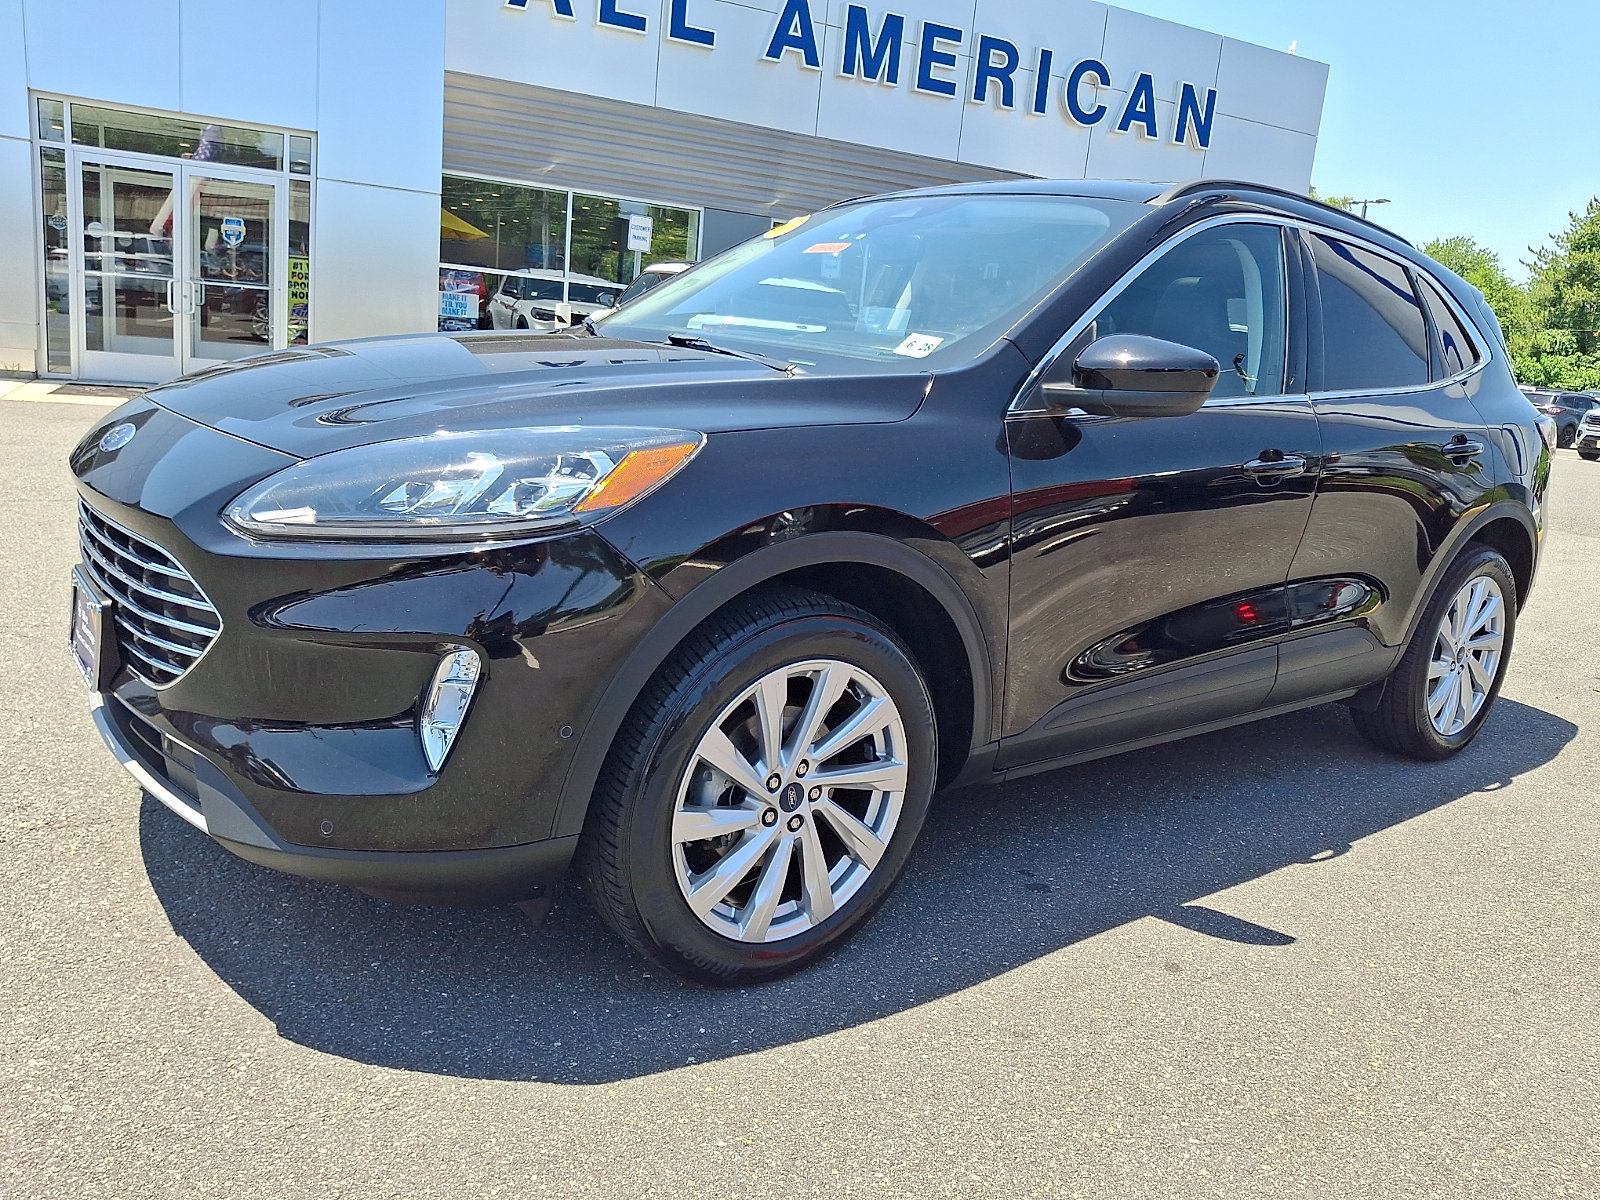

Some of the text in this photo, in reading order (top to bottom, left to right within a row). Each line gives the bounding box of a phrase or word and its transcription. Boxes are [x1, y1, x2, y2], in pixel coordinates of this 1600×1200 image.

[504, 0, 1218, 150] LL AMERICAN
[442, 293, 461, 301] MAKE
[455, 301, 468, 310] YOU
[442, 307, 468, 316] MAKE IT
